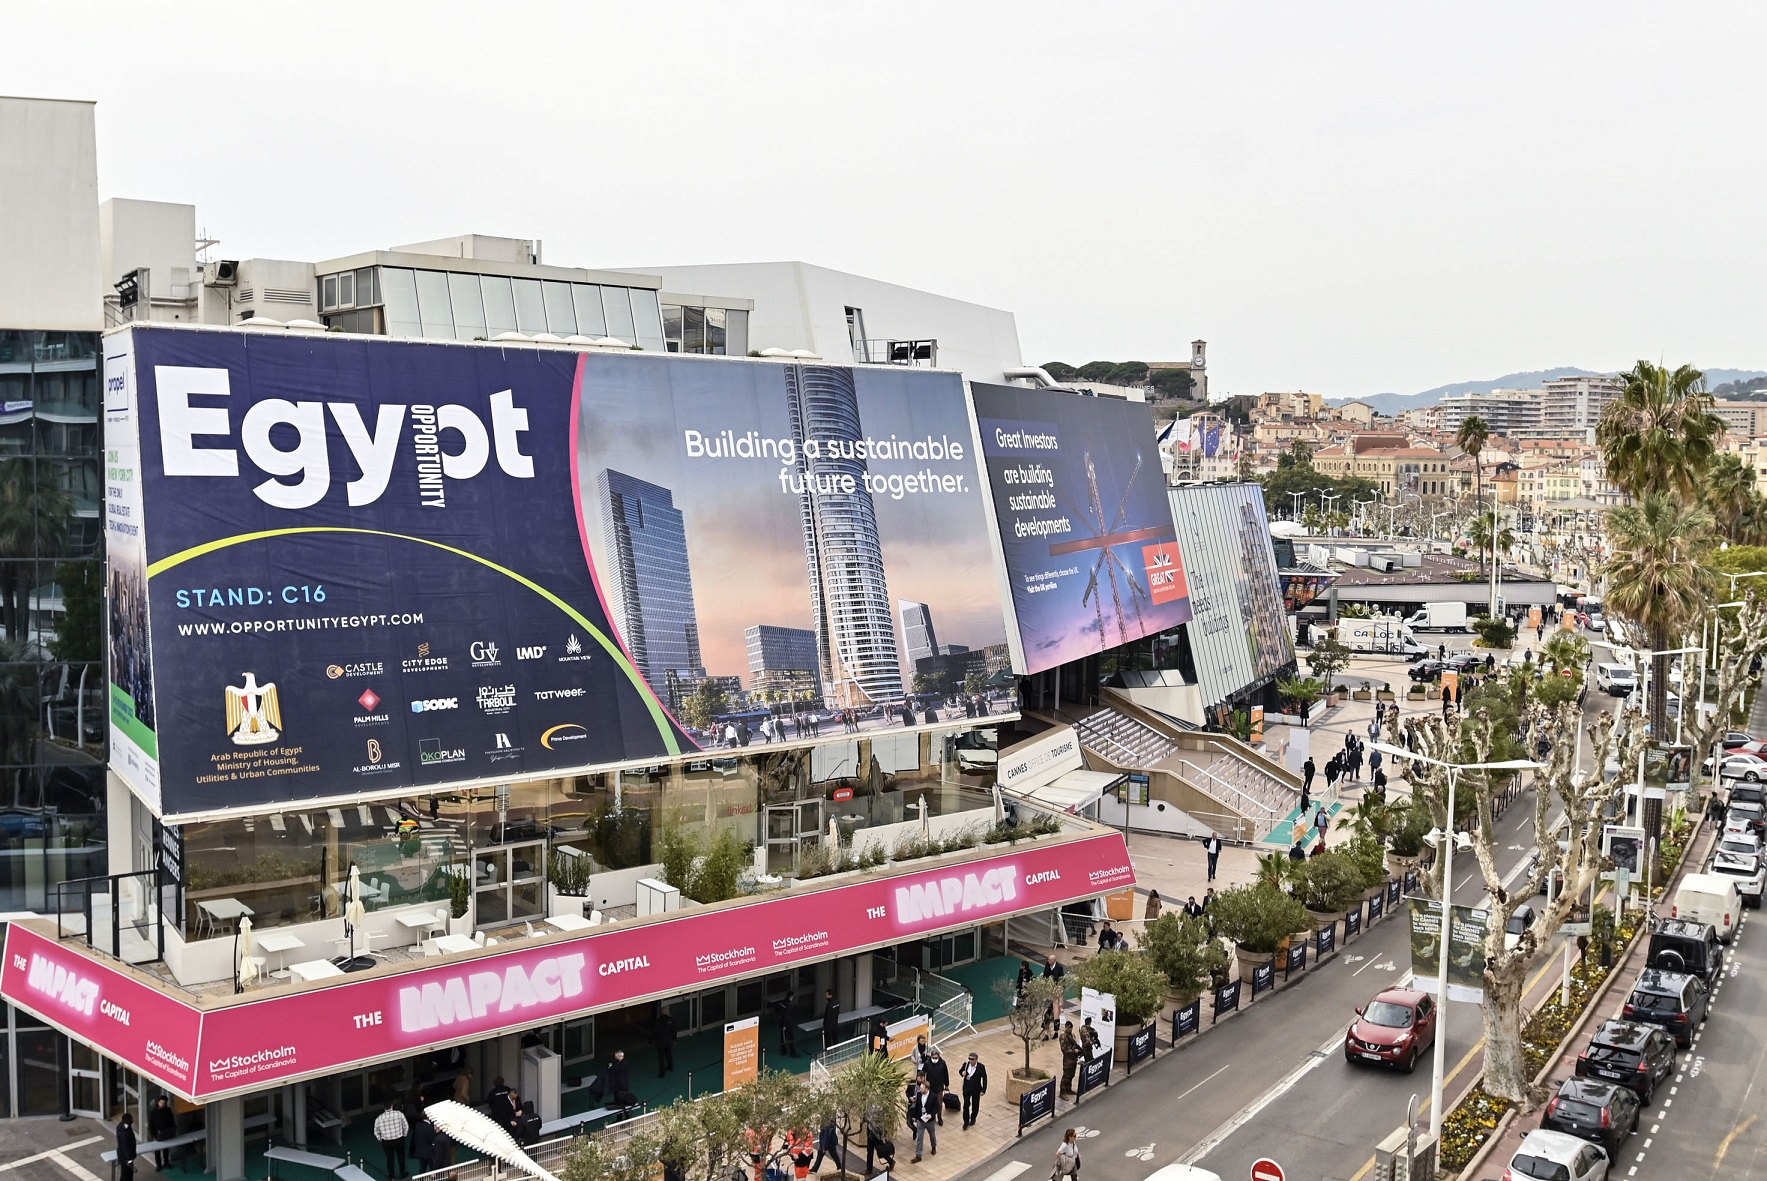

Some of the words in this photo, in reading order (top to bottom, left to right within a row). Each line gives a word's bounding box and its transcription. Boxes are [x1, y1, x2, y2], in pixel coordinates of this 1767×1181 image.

[108, 371, 125, 396] propel
[154, 365, 535, 510] Egypt
[995, 428, 1022, 449] Great
[1021, 429, 1058, 450] Investors
[410, 403, 446, 509] OPPORTUNITY
[684, 430, 795, 465] Building
[802, 442, 820, 459] a
[828, 434, 964, 460] sustainable
[779, 467, 856, 494] future
[861, 469, 969, 500] together.
[1004, 468, 1019, 484] are
[1019, 464, 1054, 487] building
[1009, 489, 1056, 511] sustainable
[1015, 516, 1071, 539] developments
[1151, 571, 1165, 586] GREAT
[176, 587, 273, 609] STAND:
[281, 585, 326, 604] C16
[1192, 596, 1211, 615] needs
[177, 614, 425, 637] WWW.OPPORTUNITYEGYPT.COM
[1201, 613, 1229, 636] buildings
[345, 662, 383, 673] CASTLE
[402, 665, 449, 673] DEVELOPMENTS
[422, 697, 459, 712] SODIC
[476, 697, 517, 709] TARBOUL
[353, 715, 371, 724] PALM
[371, 714, 389, 722] HILLS
[210, 753, 231, 762] Arab
[232, 749, 268, 760] Republic
[270, 747, 279, 755] of
[280, 746, 303, 757] Egypt
[217, 761, 251, 771] Ministry
[253, 759, 262, 767] of
[263, 756, 299, 766] Housing,
[1007, 762, 1028, 779] CANNES
[1027, 754, 1044, 770] OFFICE
[1044, 751, 1051, 762] DE
[1051, 741, 1073, 758] TOURISME
[196, 773, 229, 784] Utilities
[231, 772, 238, 780] &
[240, 770, 265, 779] Urban
[267, 764, 320, 776] Communities
[352, 763, 387, 773] AL-BOROUJ
[1099, 865, 1130, 878] Stockholm
[866, 905, 887, 920] THE
[895, 865, 1019, 924] IMPACT
[1025, 869, 1061, 886] CAPITAL
[783, 946, 799, 955] Capital
[804, 940, 829, 950] Scandinavia
[786, 931, 828, 947] Stockholm
[707, 963, 723, 973] Capital
[729, 956, 756, 966] Scandinavia
[710, 947, 755, 963] Stockholm
[1258, 965, 1270, 978] Egypt
[13, 953, 27, 971] THE
[28, 952, 100, 1016] IMPACT
[100, 999, 131, 1026] CAPITAL
[353, 1011, 383, 1029] THE
[399, 952, 586, 1033] IMPACT
[598, 955, 650, 977] CAPITAL
[1222, 986, 1235, 998] Egypt
[1180, 1007, 1193, 1021] Egypt
[887, 1035, 918, 1050] GISTRATION
[1135, 1032, 1149, 1046] Egypt
[156, 1044, 189, 1072] Stockholm
[231, 1046, 296, 1068] Stockholm
[151, 1055, 163, 1070] Capital
[166, 1063, 187, 1081] Scandinavia
[211, 1072, 224, 1082] The
[225, 1067, 249, 1080] Capital
[249, 1064, 257, 1073] of
[257, 1058, 297, 1071] Scandinavia
[1088, 1060, 1103, 1074] Egypt
[1030, 1087, 1048, 1104] Egypt
